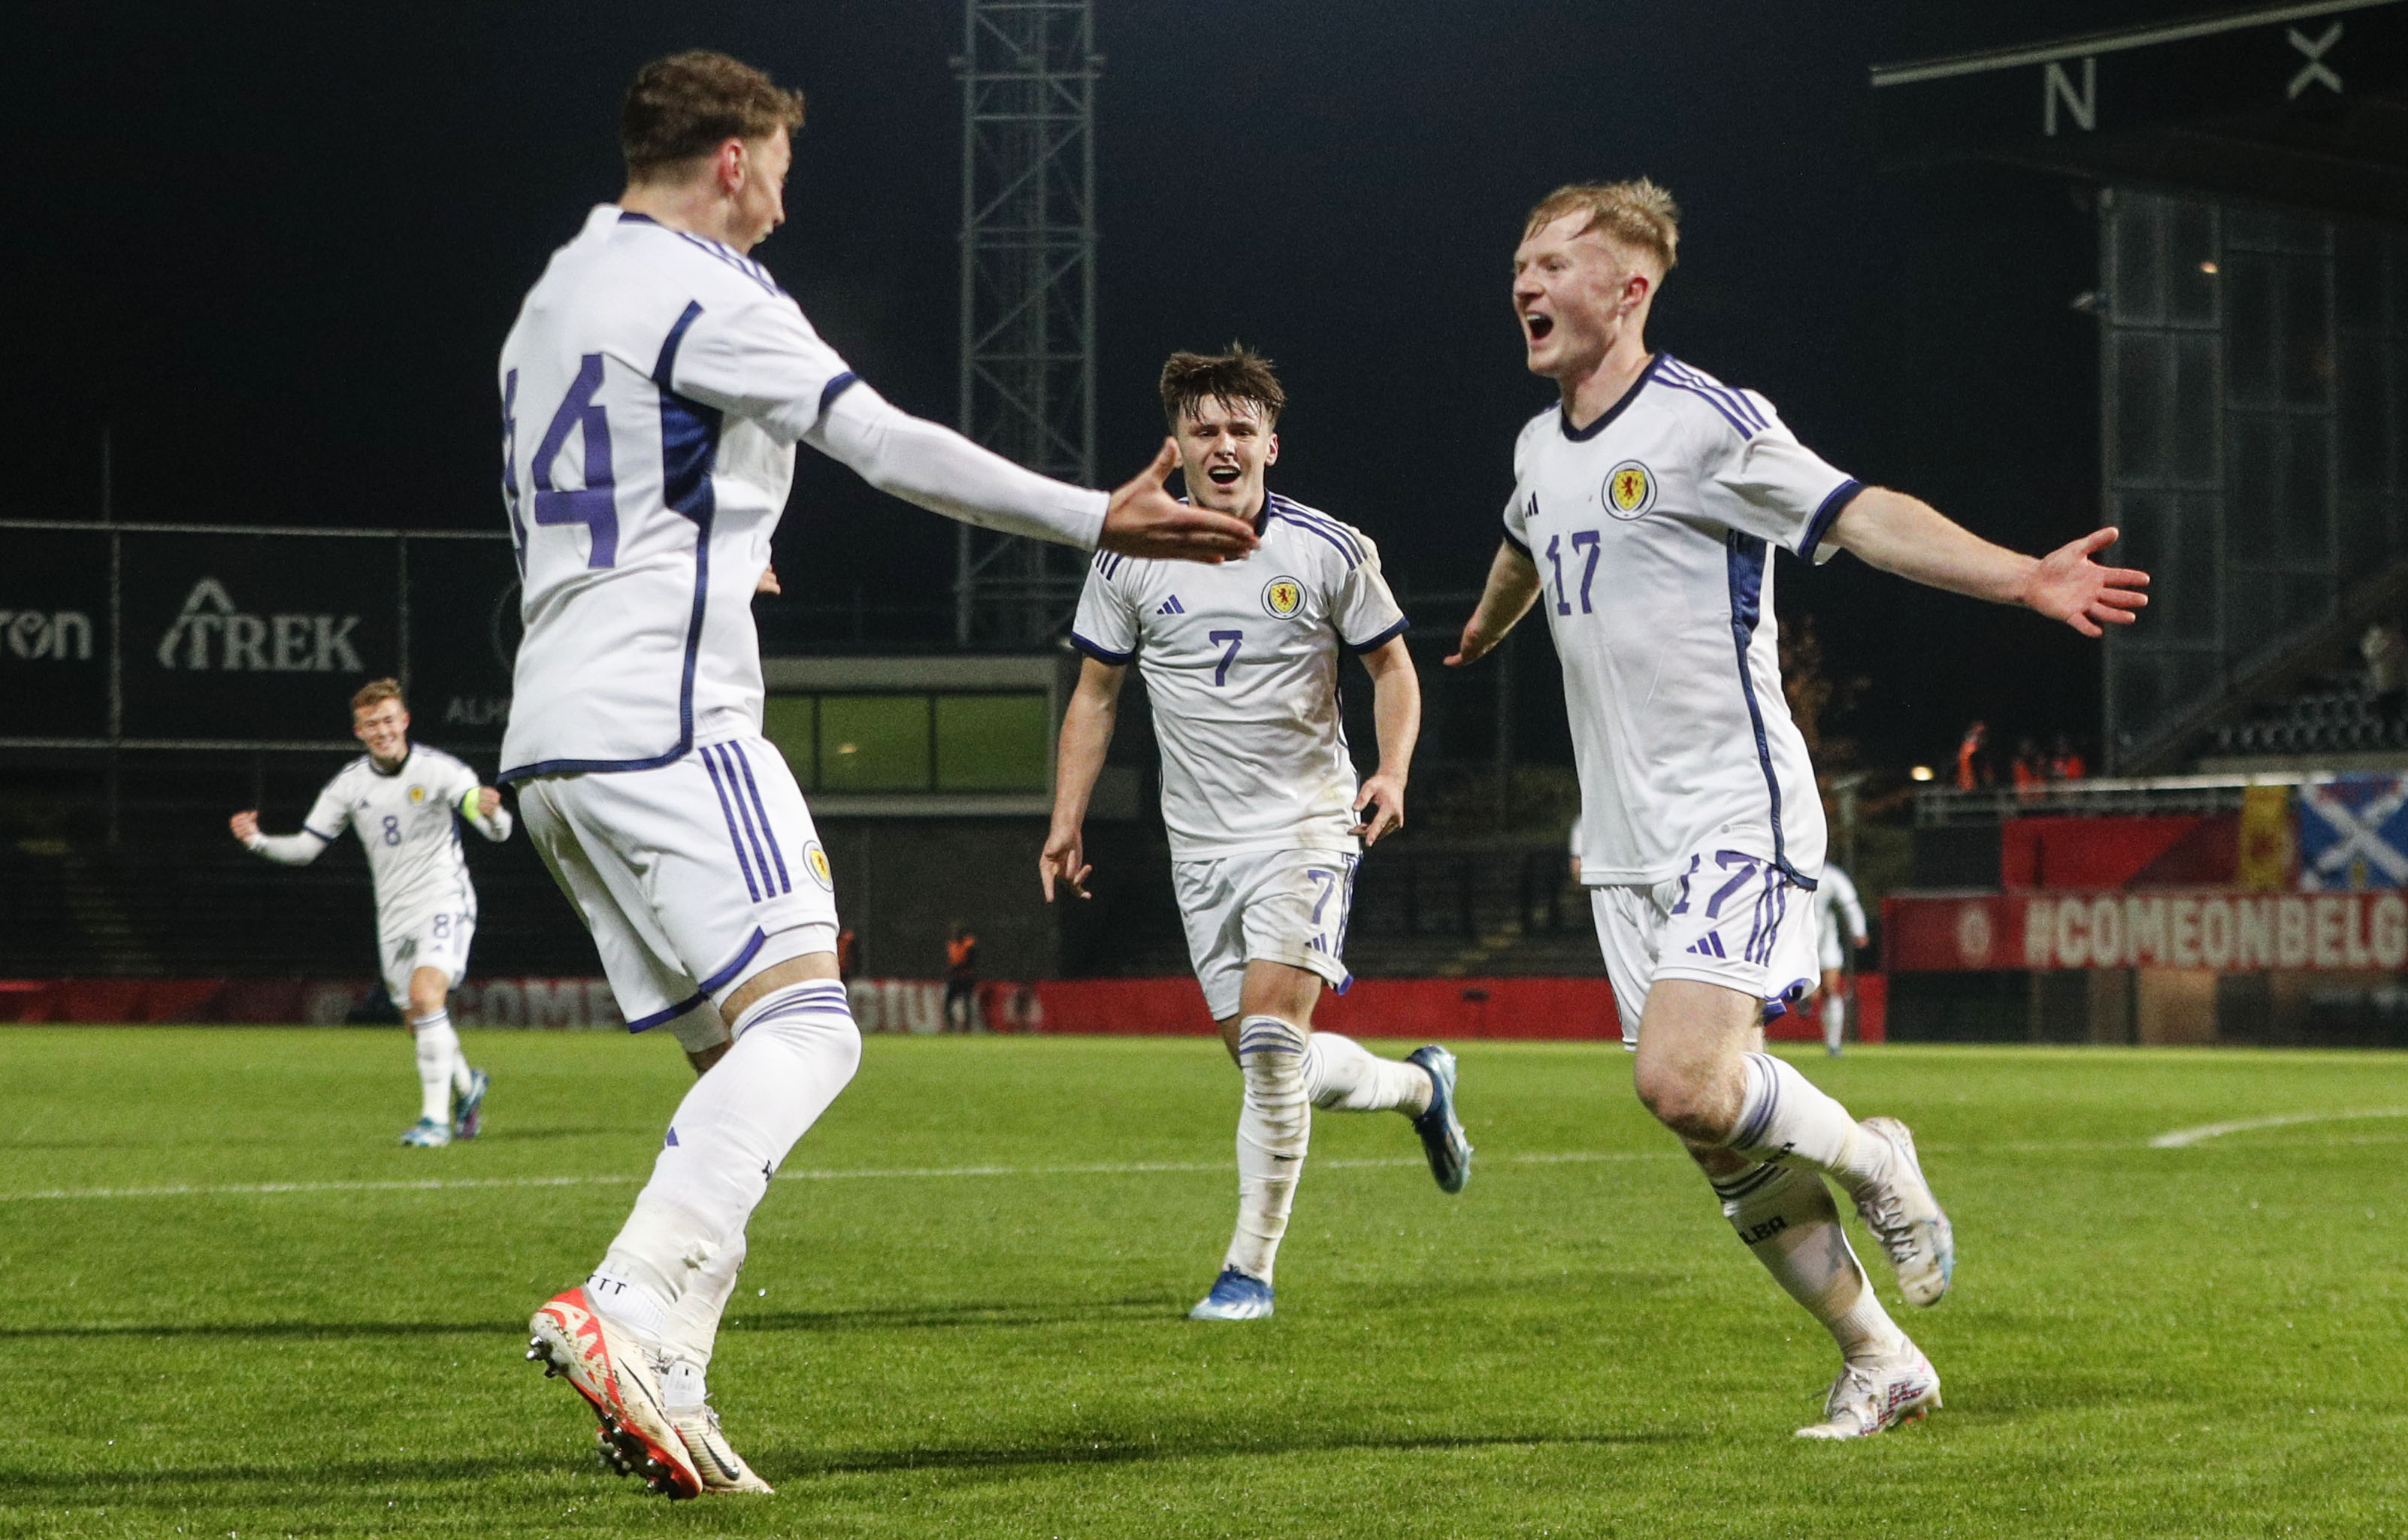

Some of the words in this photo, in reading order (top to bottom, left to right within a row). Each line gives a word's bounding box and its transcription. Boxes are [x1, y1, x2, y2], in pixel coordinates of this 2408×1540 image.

[1545, 530, 1601, 616] 17
[1209, 630, 1244, 687] 7
[382, 815, 401, 846] 8
[1306, 869, 1336, 925] 7
[1670, 849, 1761, 920] 17
[432, 913, 450, 939] 8
